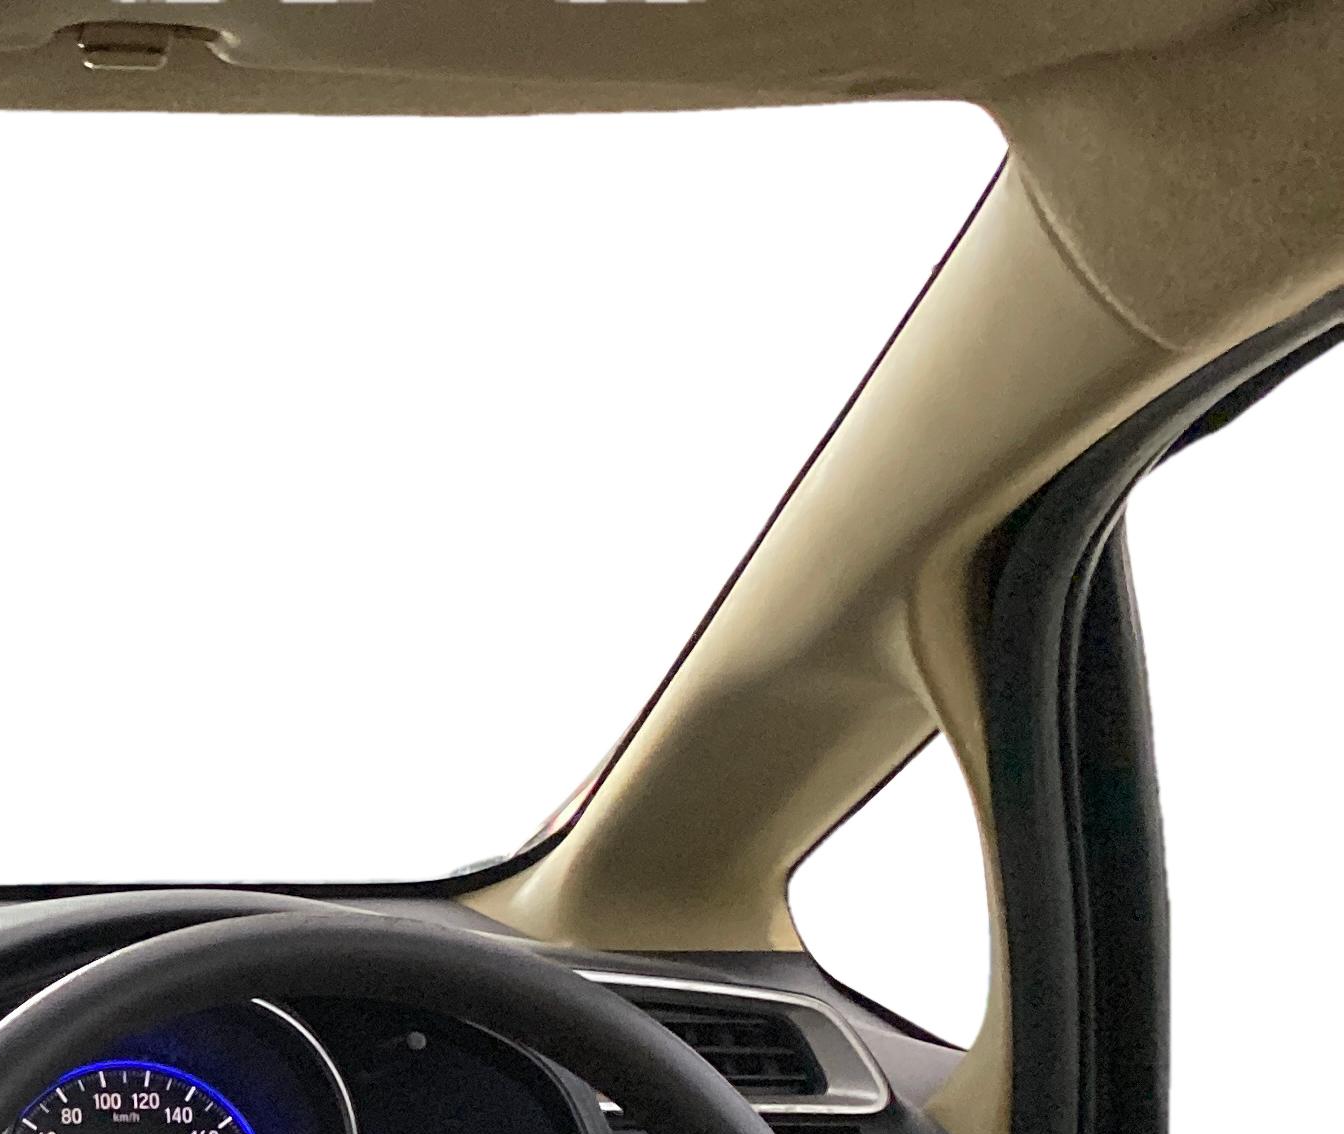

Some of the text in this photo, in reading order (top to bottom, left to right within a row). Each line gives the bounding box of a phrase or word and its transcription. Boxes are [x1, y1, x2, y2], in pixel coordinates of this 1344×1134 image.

[93, 1093, 122, 1110] 100
[132, 1093, 160, 1110] 120
[61, 1107, 83, 1125] 80
[113, 1112, 140, 1123] km/h
[164, 1106, 193, 1124] 140
